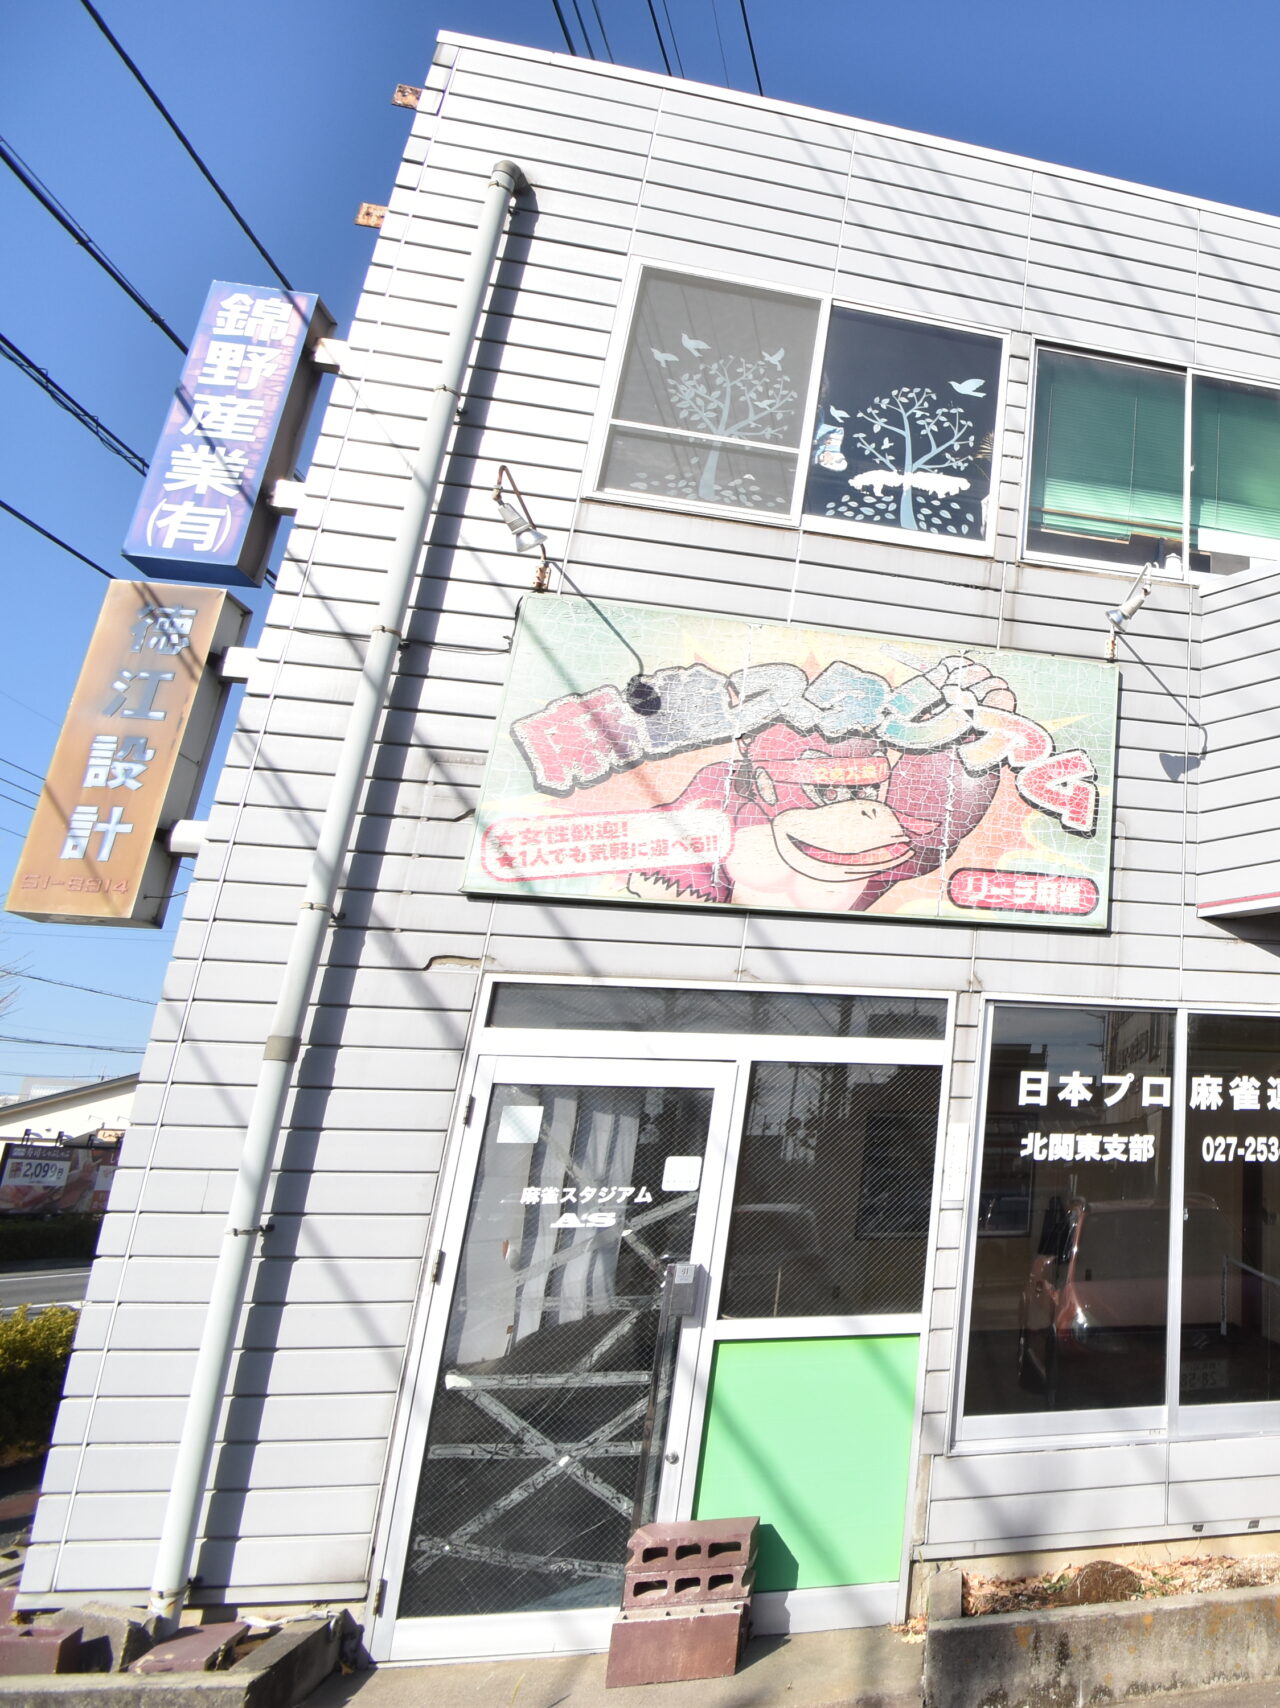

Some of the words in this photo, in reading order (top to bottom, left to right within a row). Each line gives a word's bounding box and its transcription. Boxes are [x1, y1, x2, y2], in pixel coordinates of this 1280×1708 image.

[146, 292, 294, 553] 錦野産業(有)
[59, 602, 198, 863] 徳江設計
[519, 1186, 653, 1205] 麻雀スタジアム
[1020, 1132, 1155, 1162] 北関東支部
